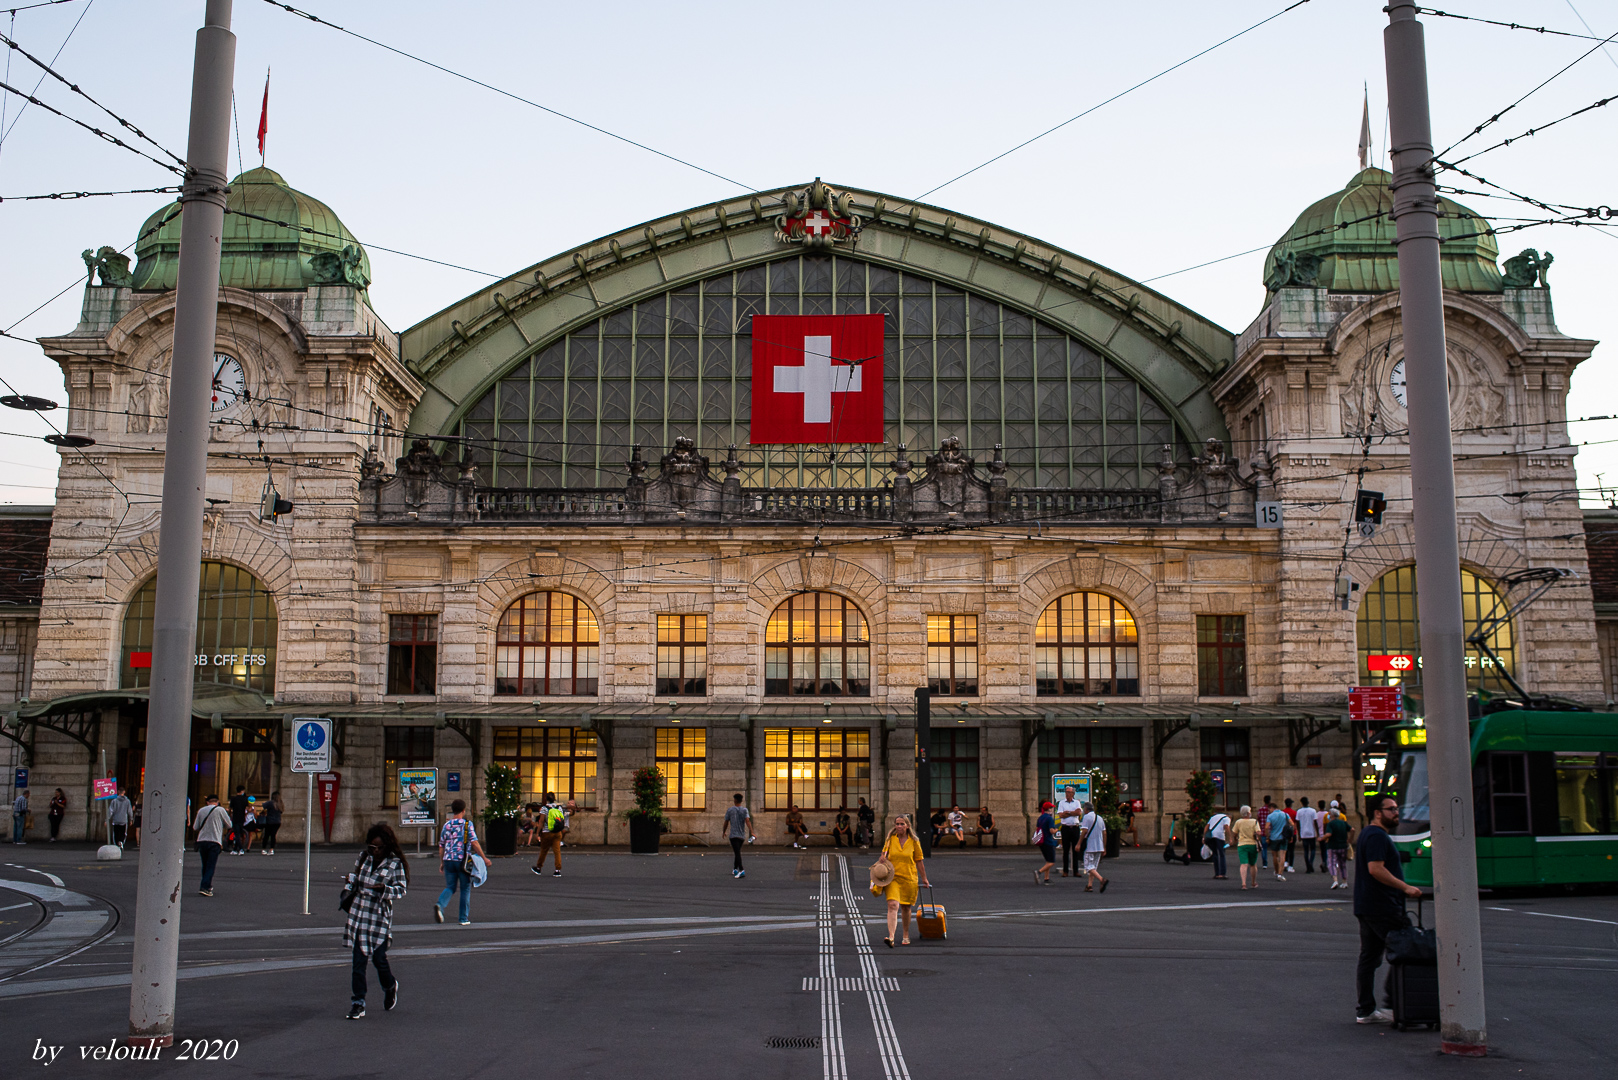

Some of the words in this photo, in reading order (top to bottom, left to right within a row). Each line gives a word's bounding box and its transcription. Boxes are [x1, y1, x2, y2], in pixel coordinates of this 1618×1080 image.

[1261, 506, 1278, 523] 15
[213, 654, 238, 666] CFF
[243, 654, 267, 666] FFS
